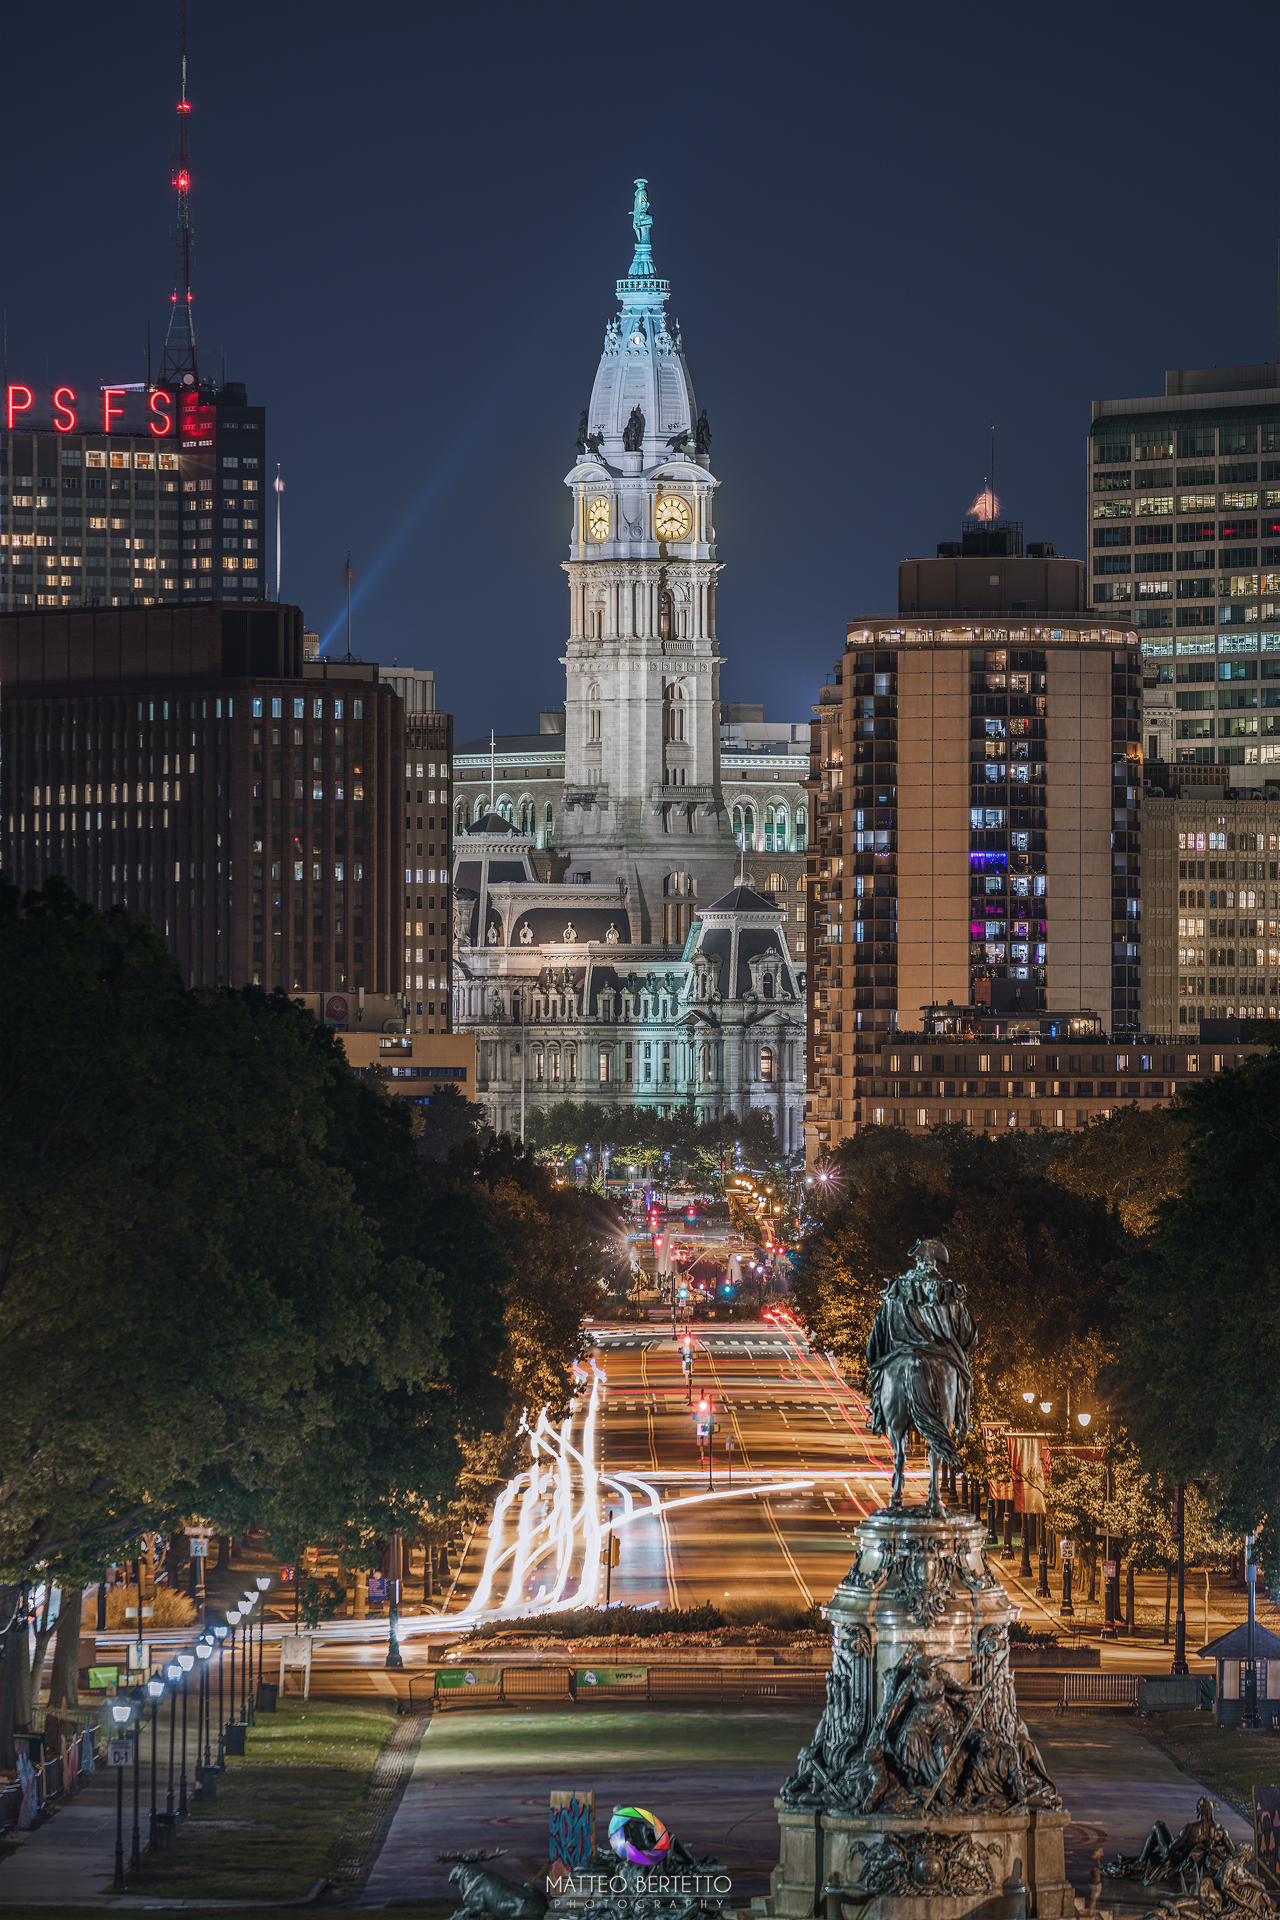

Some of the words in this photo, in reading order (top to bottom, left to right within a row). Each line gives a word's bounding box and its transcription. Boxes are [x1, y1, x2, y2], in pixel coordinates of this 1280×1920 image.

[7, 386, 171, 435] PSFS
[1062, 1550, 1073, 1558] 25
[113, 1750, 129, 1764] D-1
